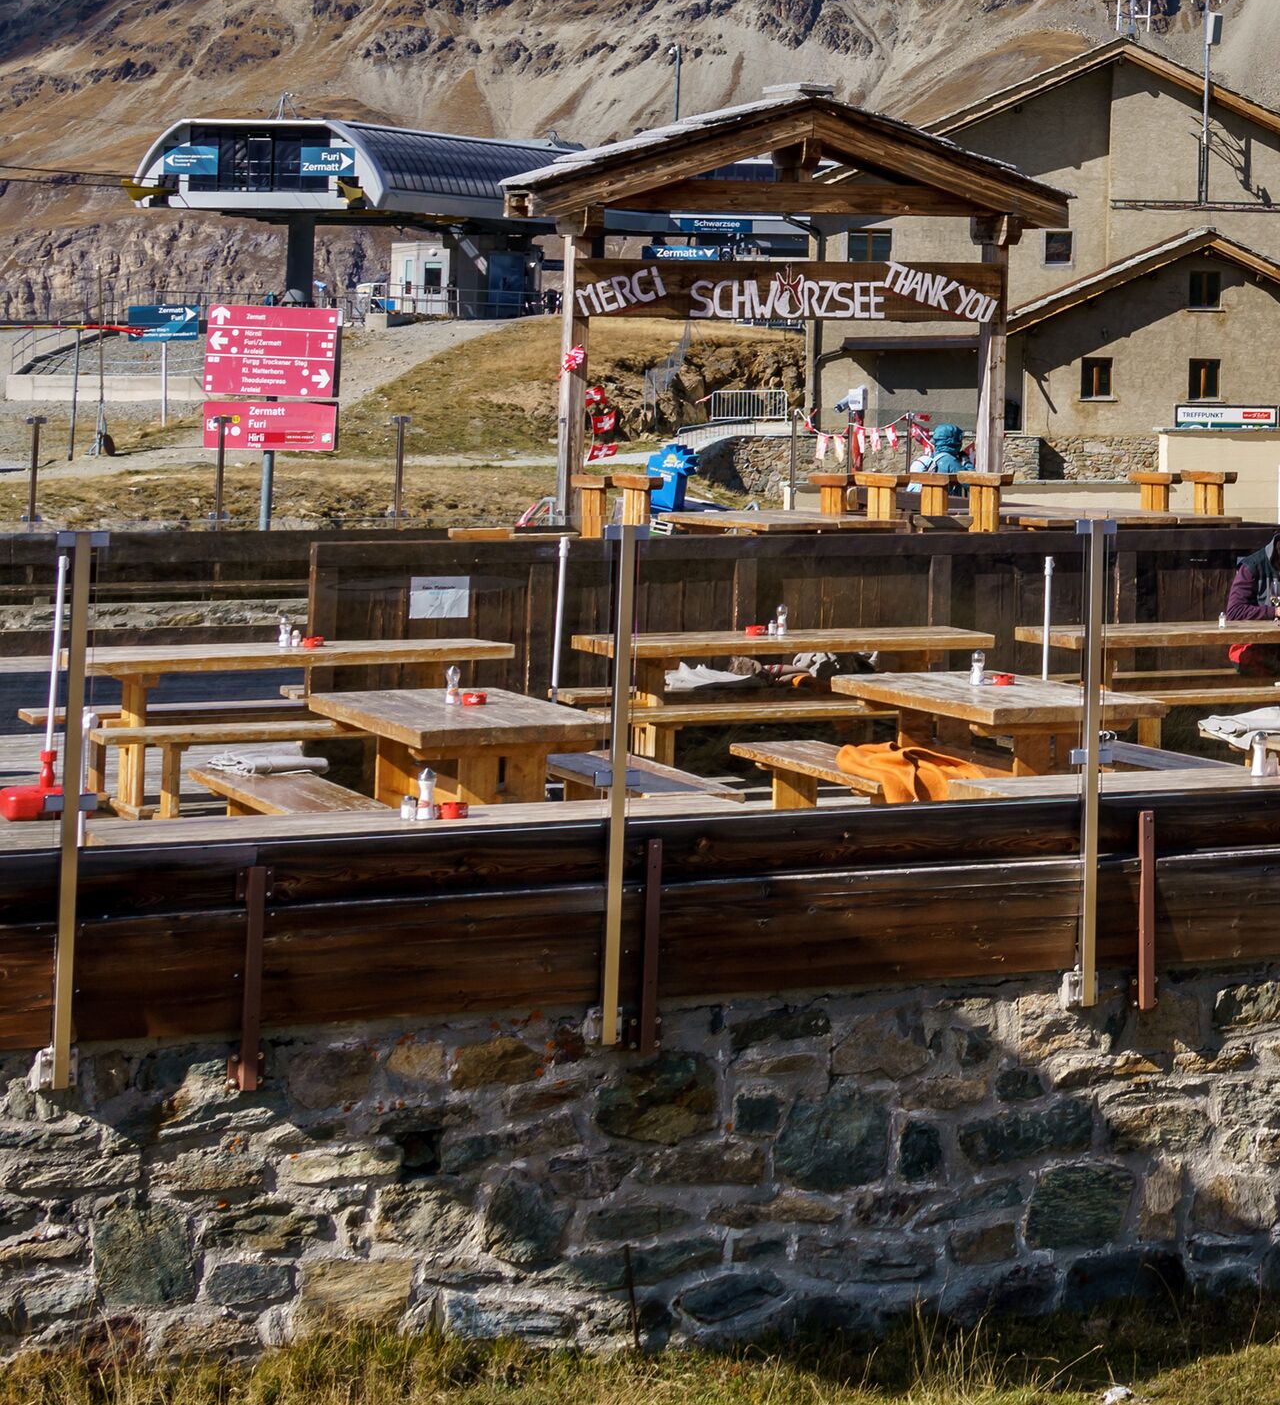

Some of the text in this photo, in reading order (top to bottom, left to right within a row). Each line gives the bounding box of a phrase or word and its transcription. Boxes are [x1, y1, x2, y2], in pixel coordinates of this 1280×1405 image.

[321, 152, 340, 161] Furi
[302, 162, 340, 172] Zermatt
[693, 219, 741, 228] Schwarzsee
[656, 248, 697, 258] Zermatt
[884, 261, 998, 323] THANK YOU
[689, 279, 885, 320] SCHWRZSEE
[246, 312, 266, 321] Zermatt
[249, 406, 286, 416] Zermatt
[1182, 411, 1224, 419] TREFFPUNKT
[248, 419, 267, 429] Furi
[247, 432, 265, 442] Hirli
